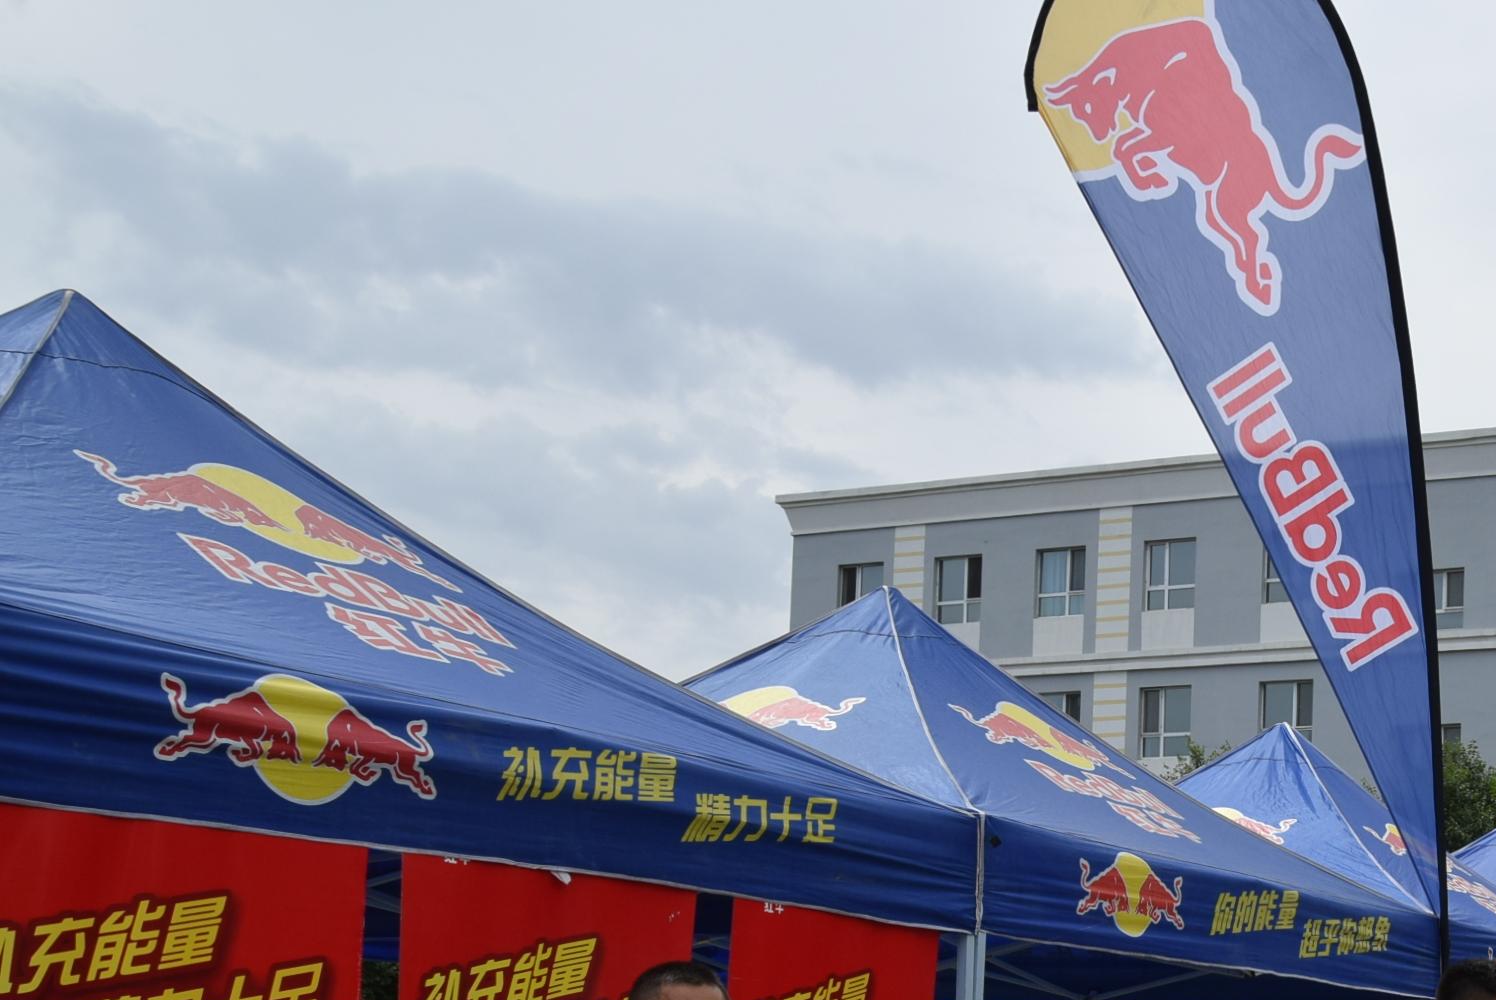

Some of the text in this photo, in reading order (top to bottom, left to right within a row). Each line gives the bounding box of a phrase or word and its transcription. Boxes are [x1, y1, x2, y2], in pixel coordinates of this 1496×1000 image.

[177, 532, 517, 649] RedBull
[326, 602, 515, 676] 红牛
[496, 746, 678, 802] 补充能量
[681, 794, 839, 844] 精力十足
[1210, 890, 1298, 936] 你的能量
[1299, 915, 1392, 959] 超乎你想象
